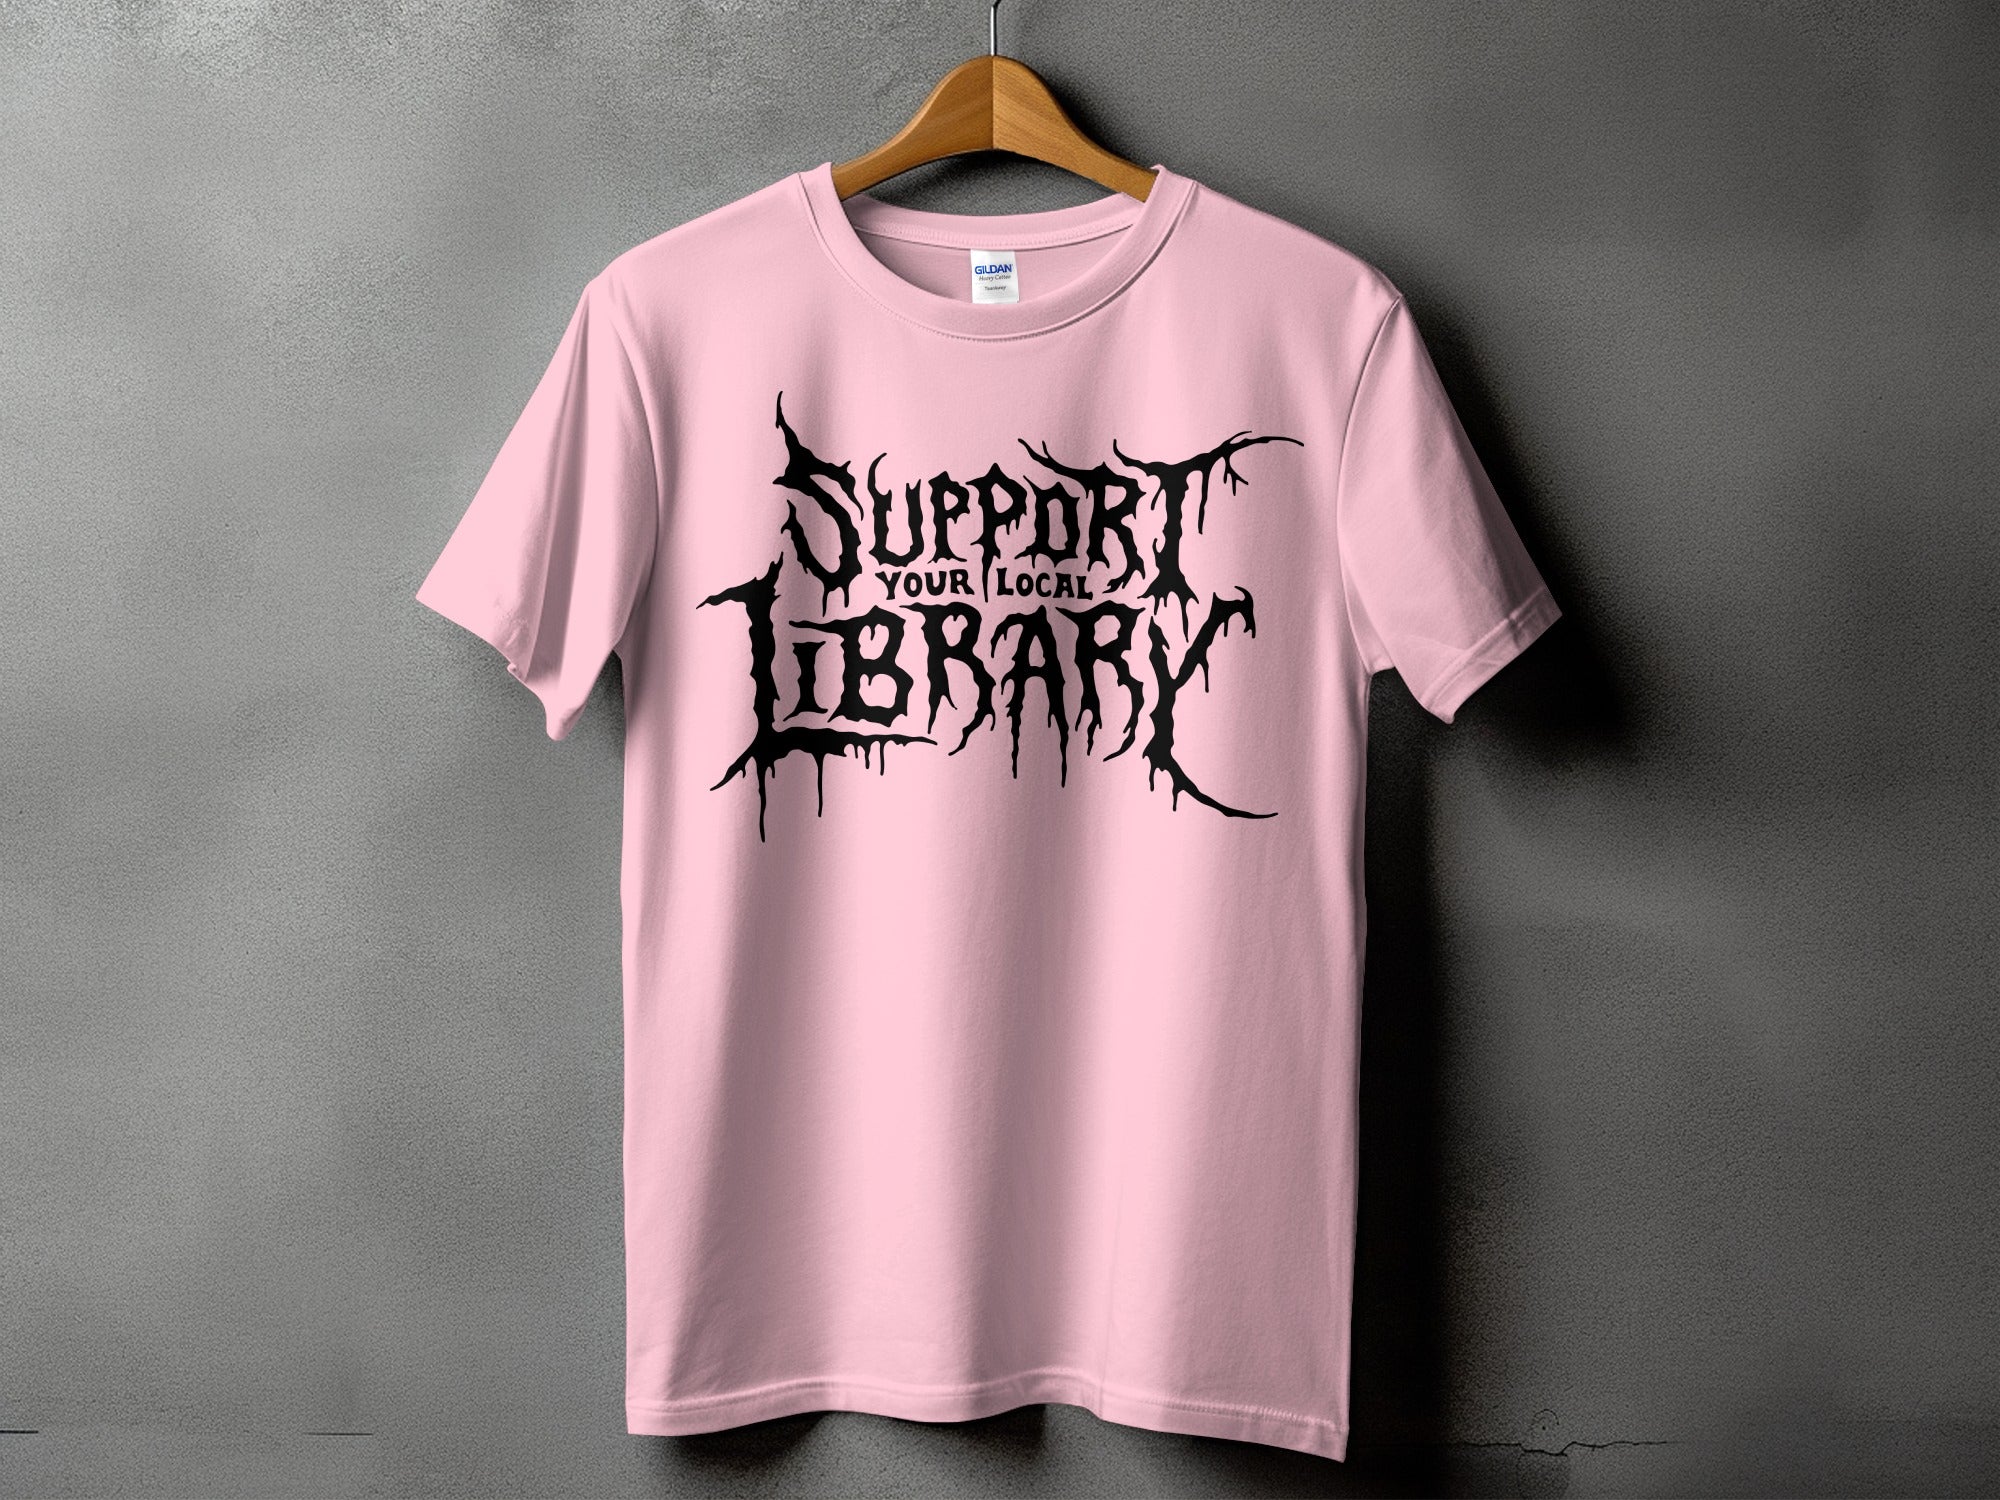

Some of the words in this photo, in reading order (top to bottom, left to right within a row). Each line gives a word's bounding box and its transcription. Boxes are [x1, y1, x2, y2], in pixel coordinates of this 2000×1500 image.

[974, 264, 1013, 275] GILDAN
[772, 390, 1305, 643] SUPPORT
[874, 568, 976, 601] YOUR
[996, 567, 1094, 601] LOCAL
[695, 551, 1279, 844] LIBRARY
